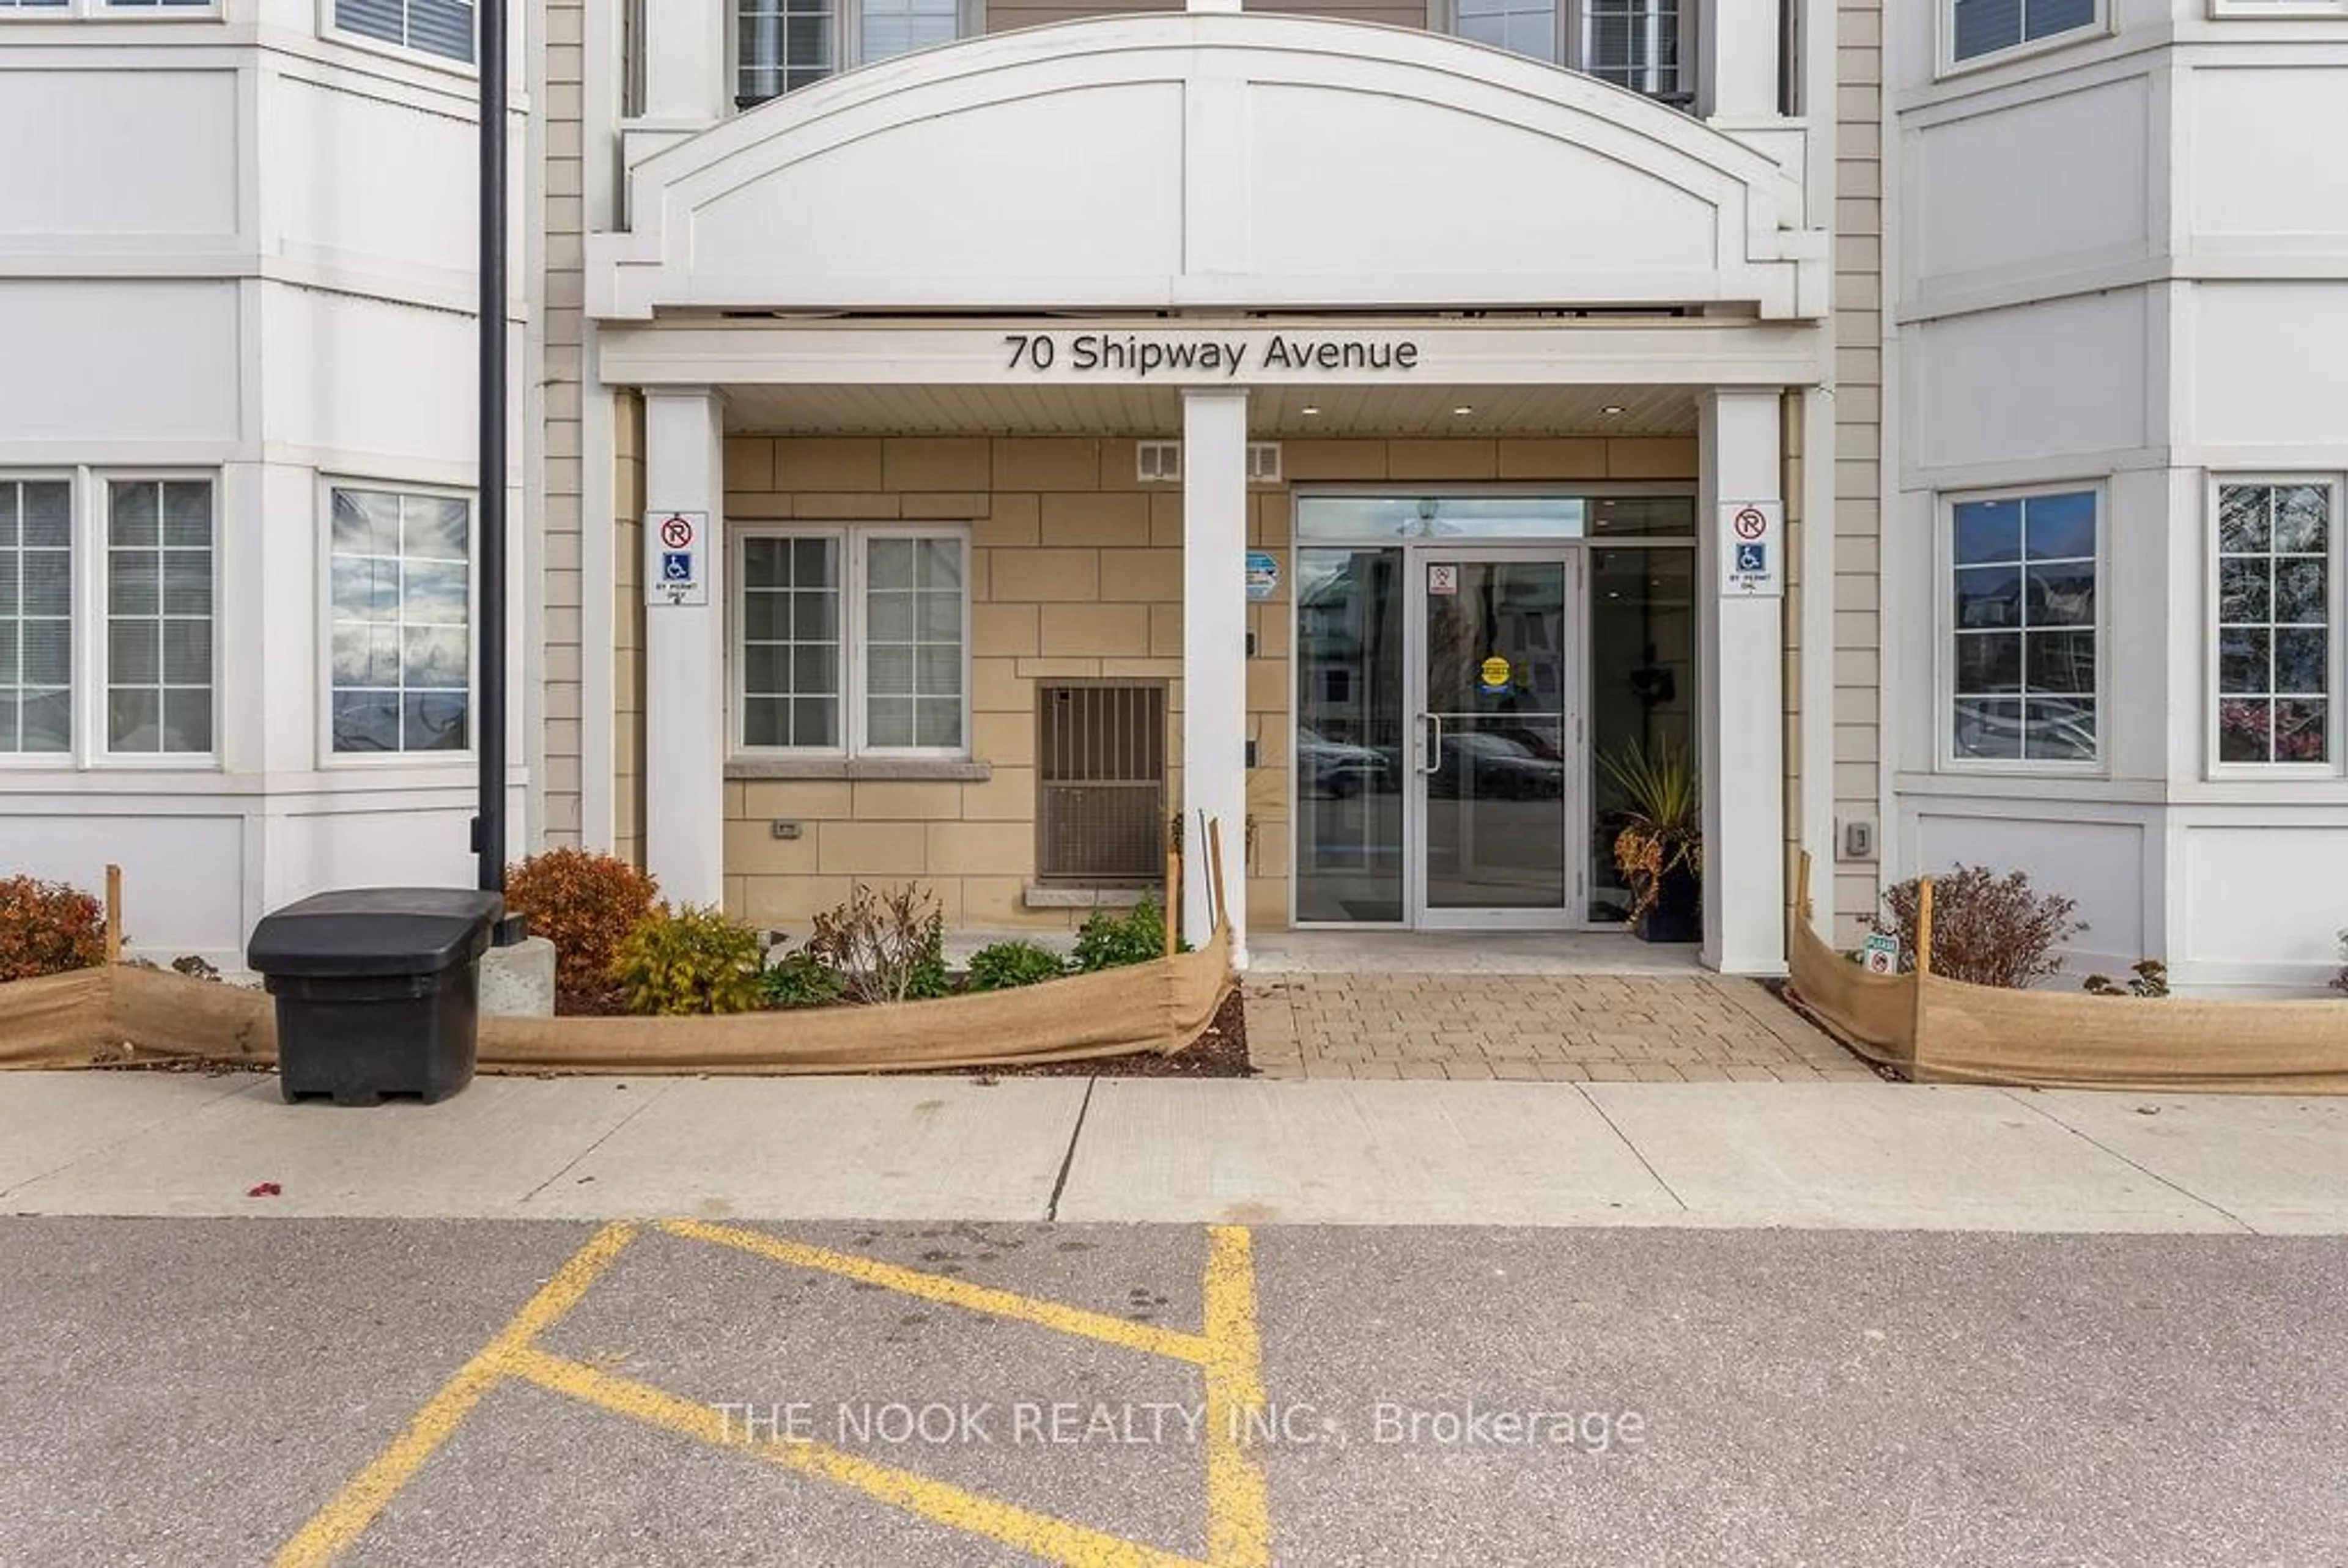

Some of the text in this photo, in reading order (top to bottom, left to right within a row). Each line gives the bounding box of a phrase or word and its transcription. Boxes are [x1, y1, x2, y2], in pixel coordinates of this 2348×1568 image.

[1006, 334, 1418, 376] 70 Shipway Avenue
